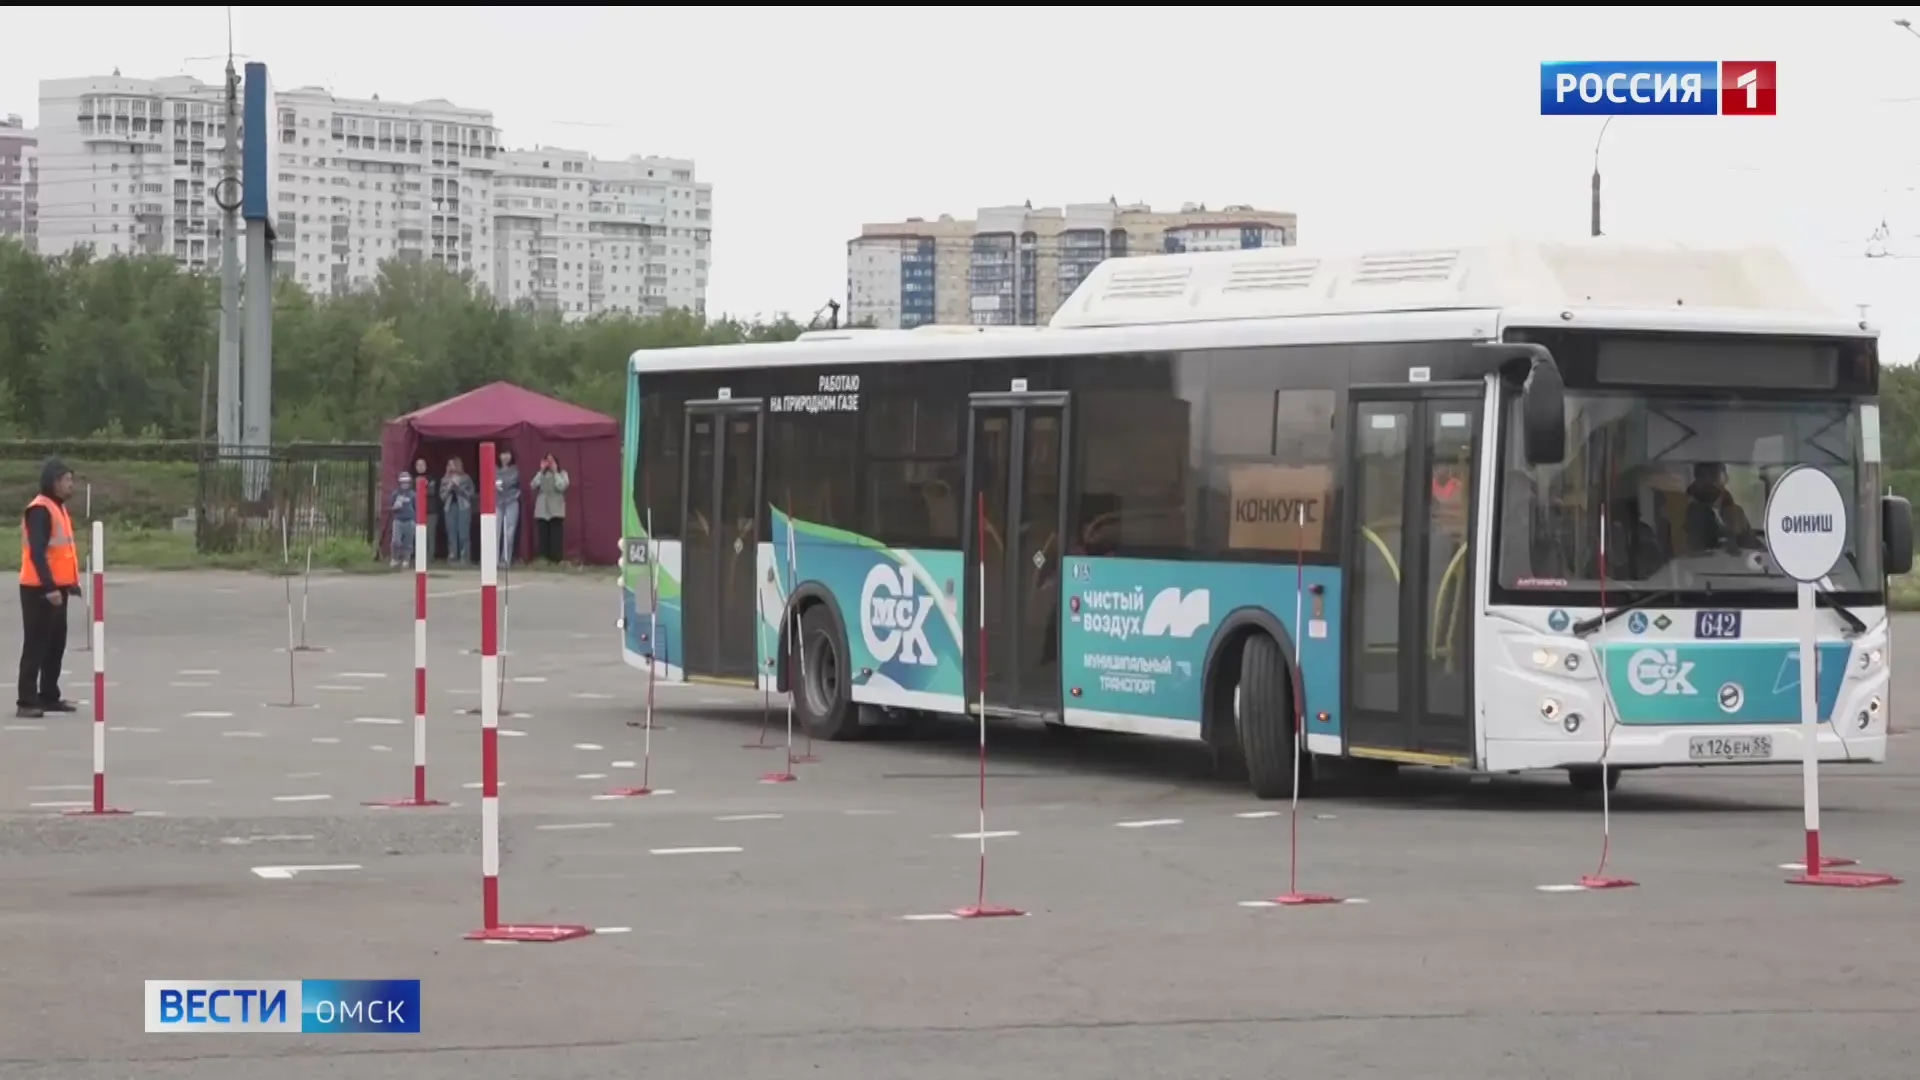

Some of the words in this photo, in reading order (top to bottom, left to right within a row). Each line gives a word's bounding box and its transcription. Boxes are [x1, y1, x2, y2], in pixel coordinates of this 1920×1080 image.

[818, 375, 860, 392] РАБОТАЮ
[770, 397, 782, 412] НА
[783, 395, 836, 414] ПРИРОДНОМ
[838, 393, 859, 411] ГАЗЕ
[1236, 498, 1319, 523] КОНКУРС
[1781, 513, 1833, 534] ФИНИШ
[1701, 613, 1736, 637] 642
[1083, 653, 1172, 675] МУНИЦИПАЛЬНЫЙ
[1099, 675, 1156, 694] ТРАНСПОРТ
